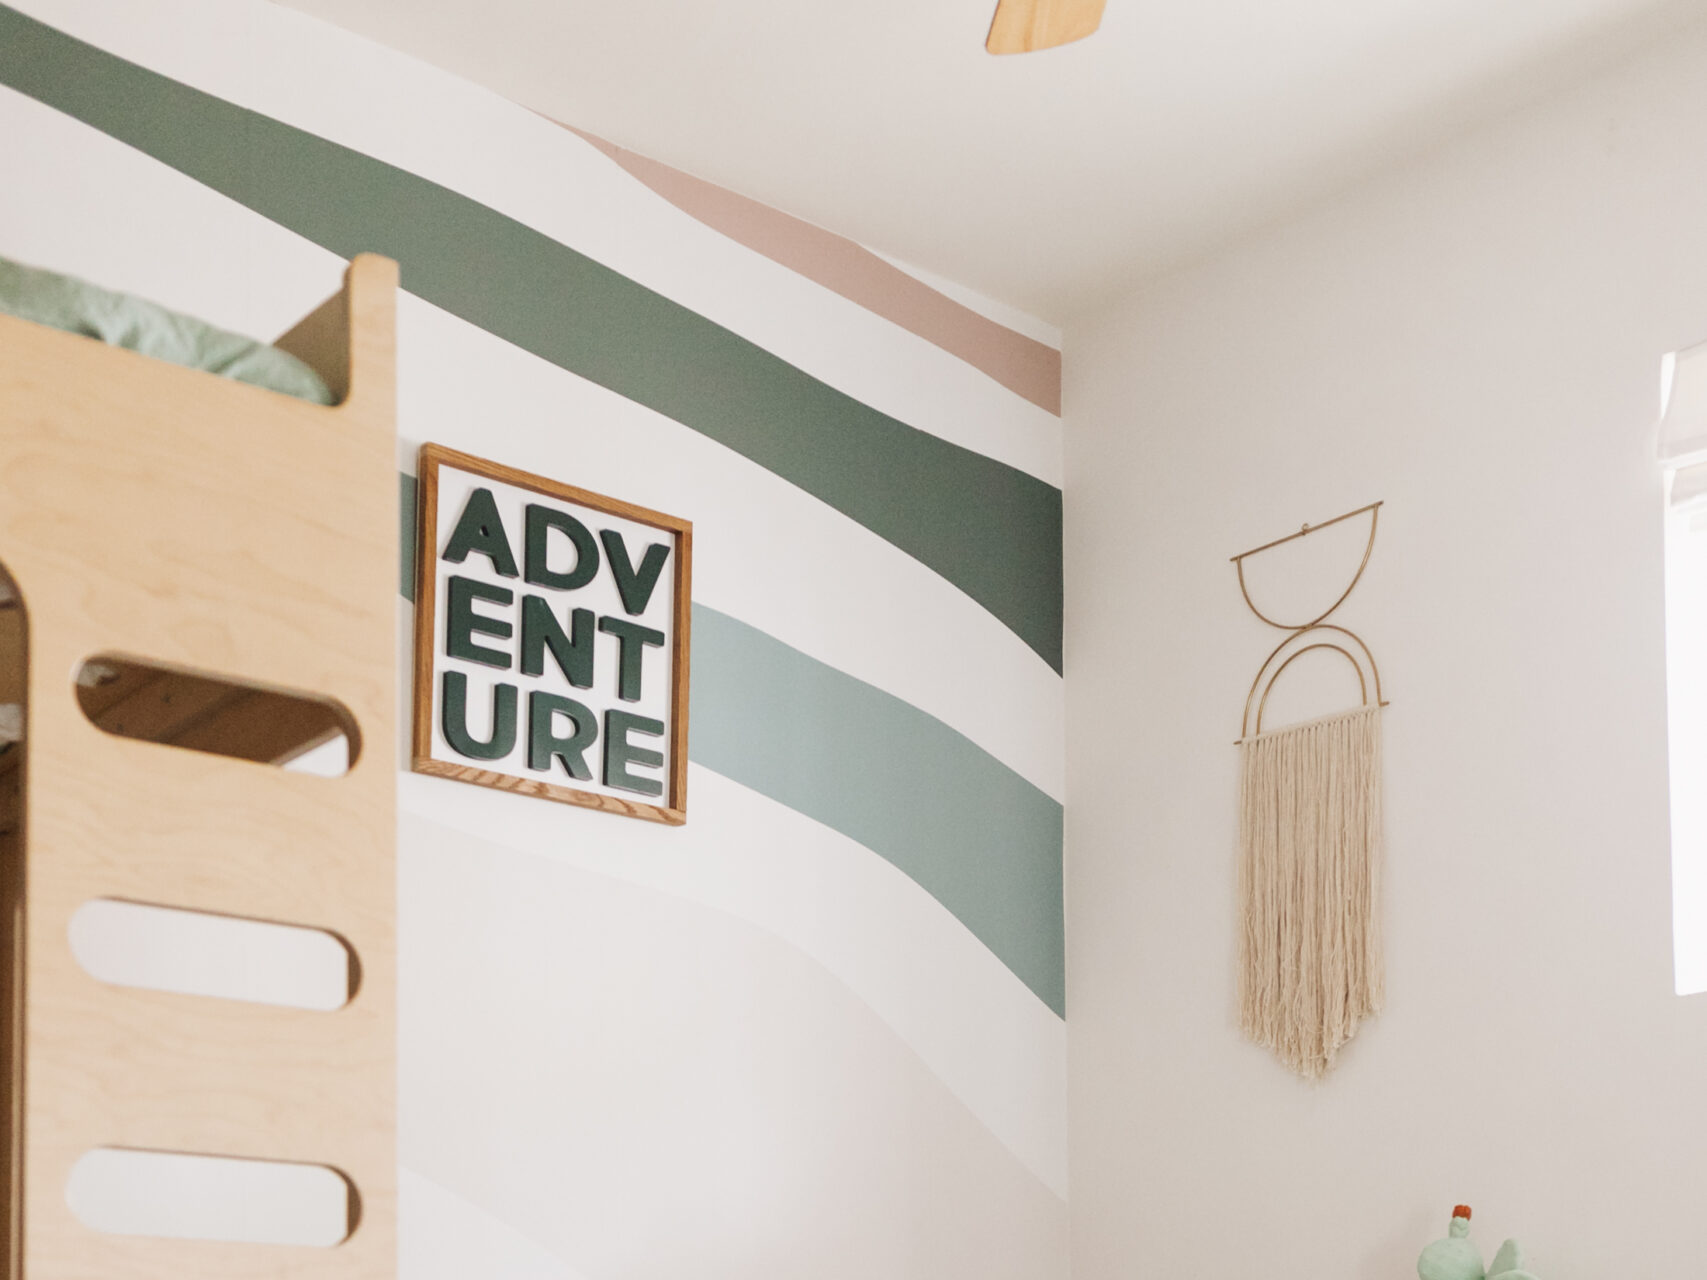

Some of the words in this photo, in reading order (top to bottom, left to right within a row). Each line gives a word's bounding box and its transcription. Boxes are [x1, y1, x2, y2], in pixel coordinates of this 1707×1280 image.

[442, 487, 671, 616] ADV
[446, 575, 665, 703] ENT
[441, 670, 665, 797] URE
